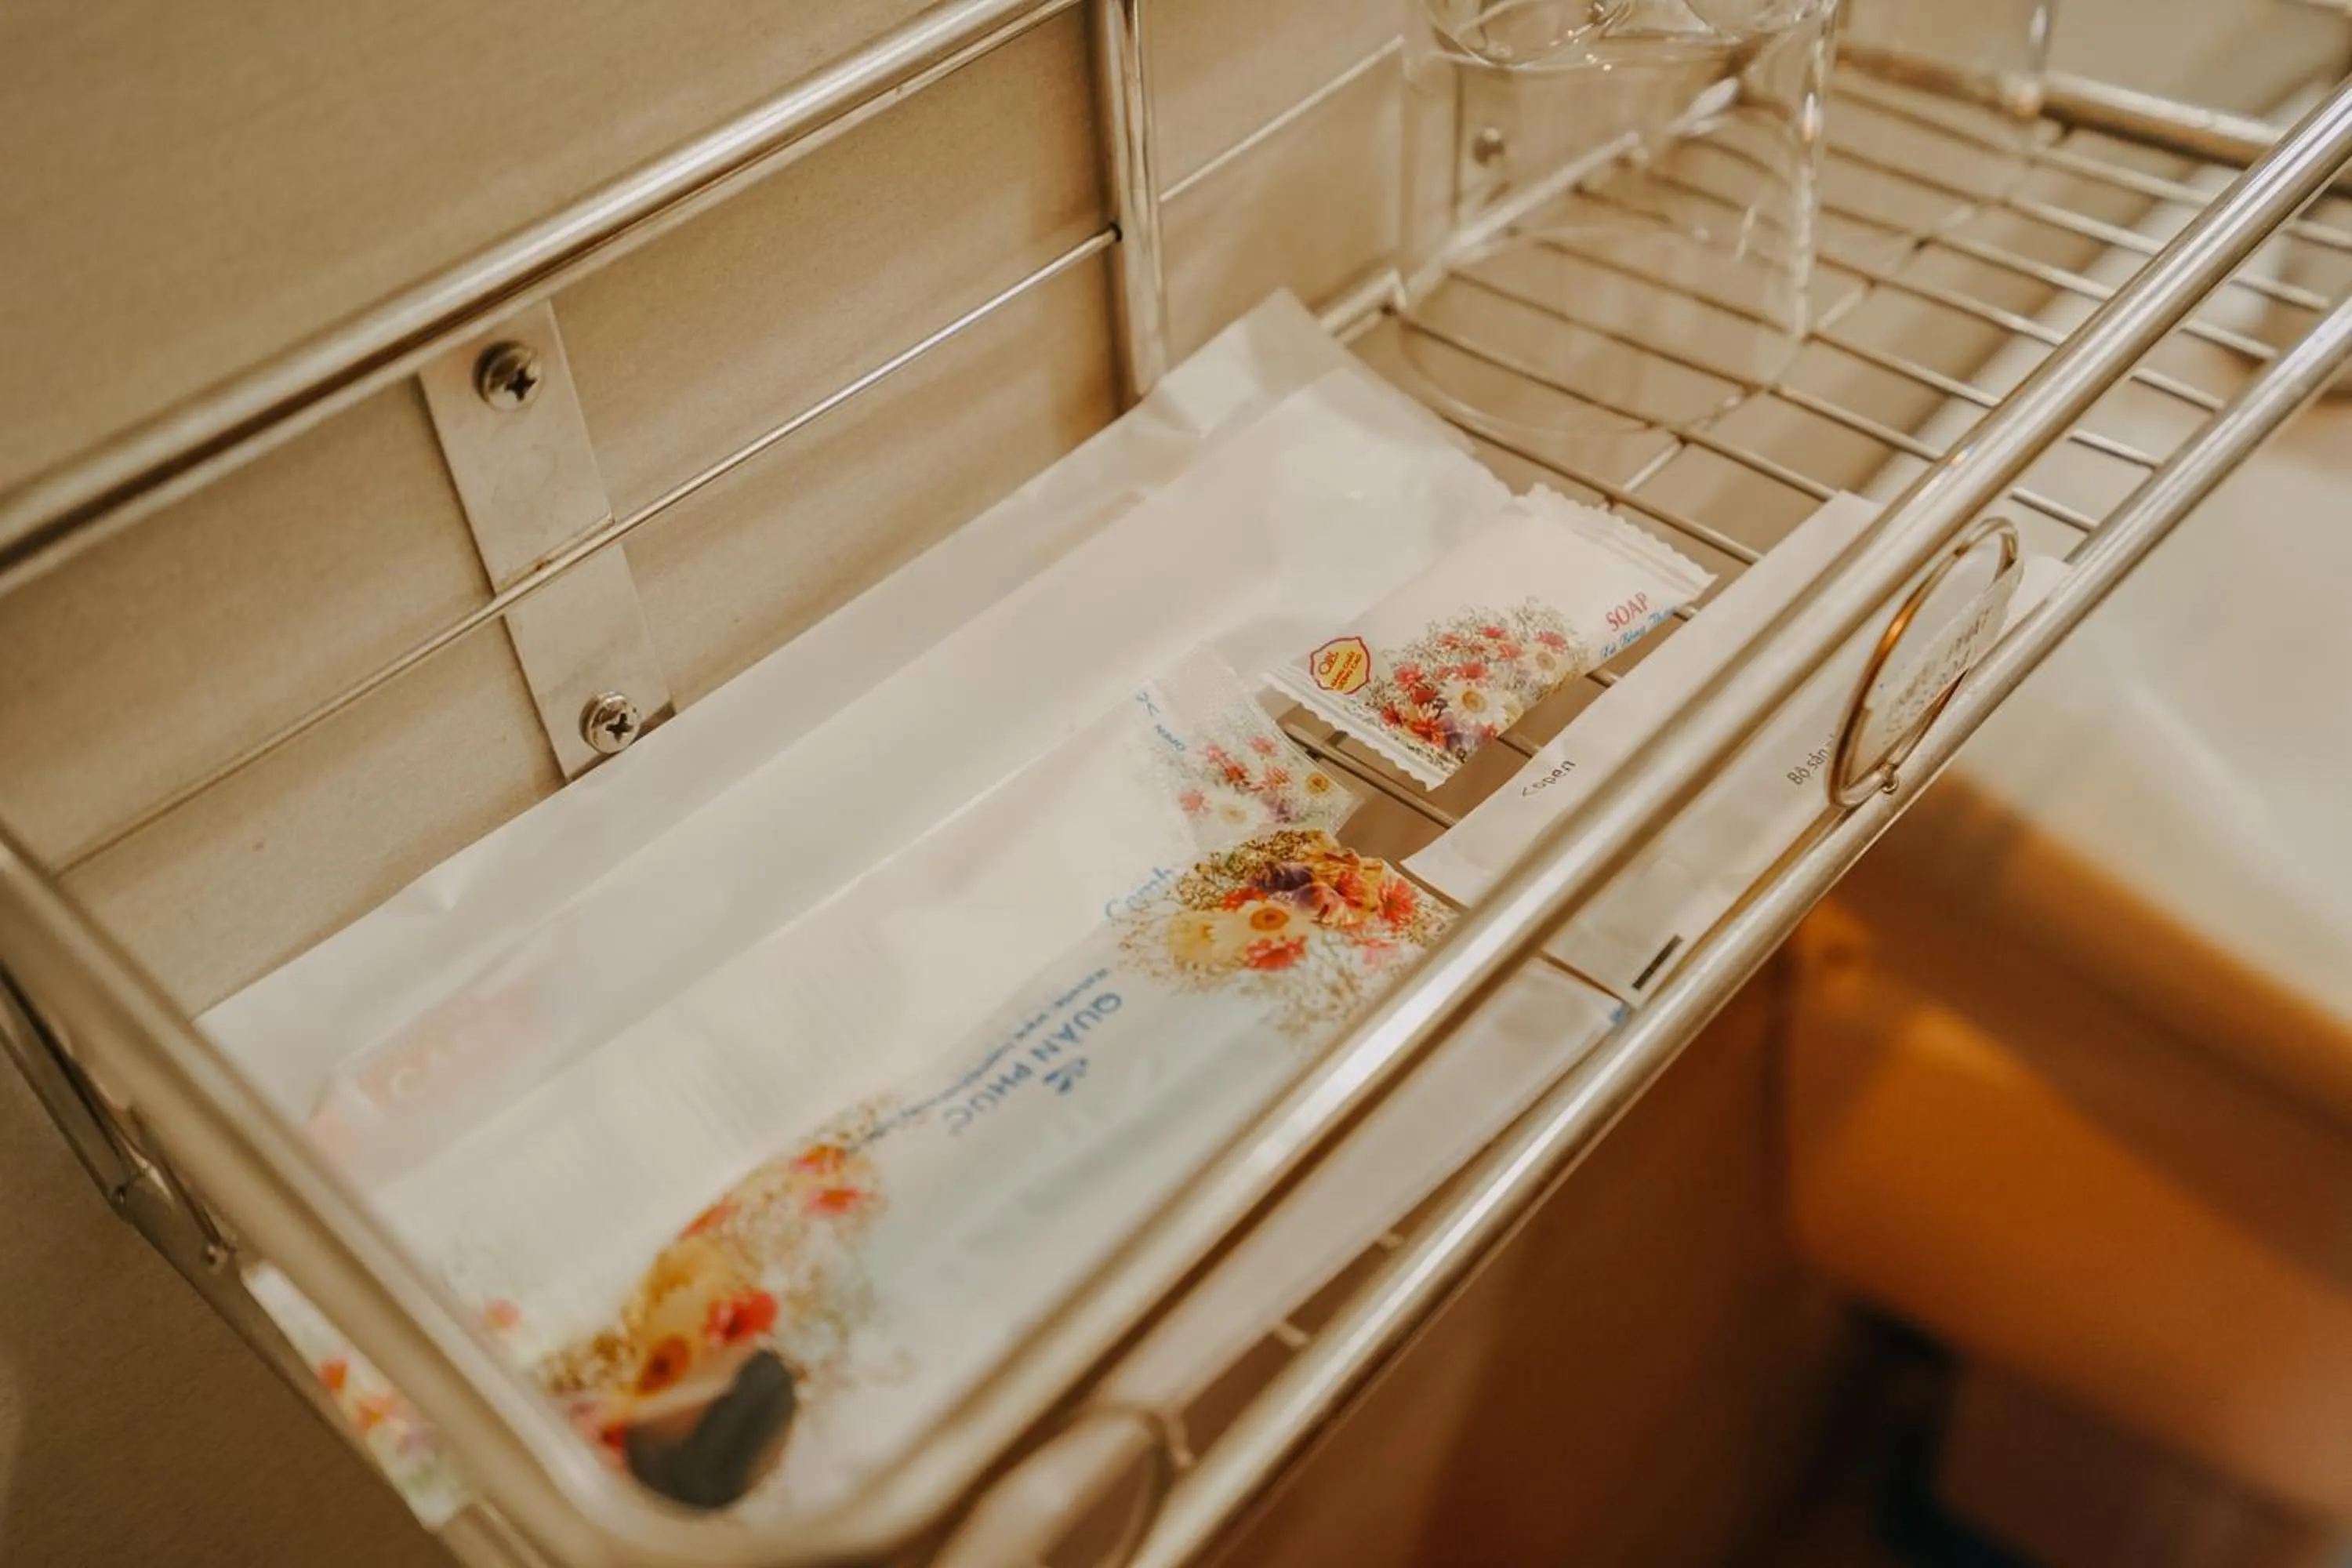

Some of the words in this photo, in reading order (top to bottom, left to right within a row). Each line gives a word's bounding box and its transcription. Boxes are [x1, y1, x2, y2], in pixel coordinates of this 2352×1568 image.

[1606, 591, 1648, 632] SOAP
[1788, 766, 1813, 785] Bộ
[1806, 749, 1828, 770] sản
